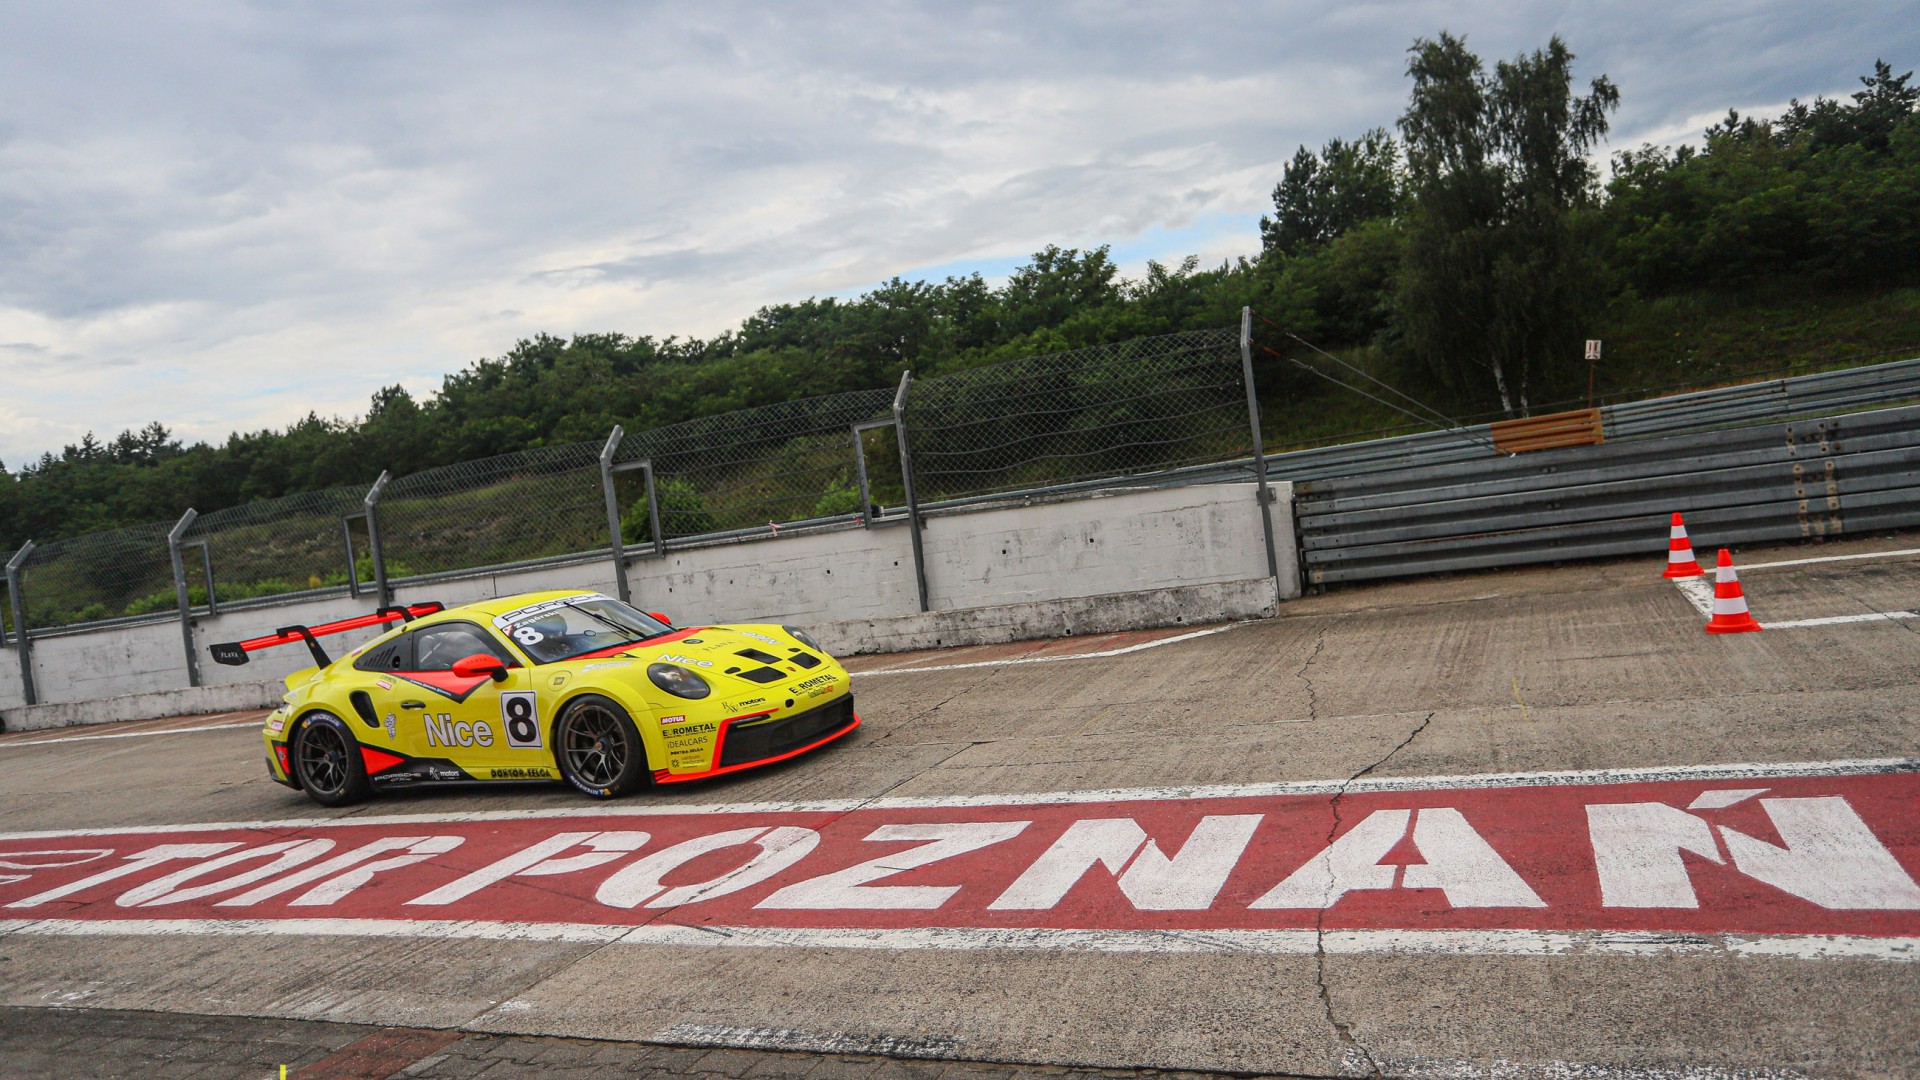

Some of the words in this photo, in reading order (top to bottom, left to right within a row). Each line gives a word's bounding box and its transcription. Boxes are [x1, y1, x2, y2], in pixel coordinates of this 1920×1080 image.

[513, 626, 545, 646] 8
[655, 653, 714, 669] Nice
[739, 697, 766, 708] motors
[506, 696, 537, 743] 8
[661, 715, 685, 725] MOTUL
[422, 713, 494, 748] Nice
[1, 835, 466, 909] TOR
[402, 788, 1920, 911] POZNAŃ
